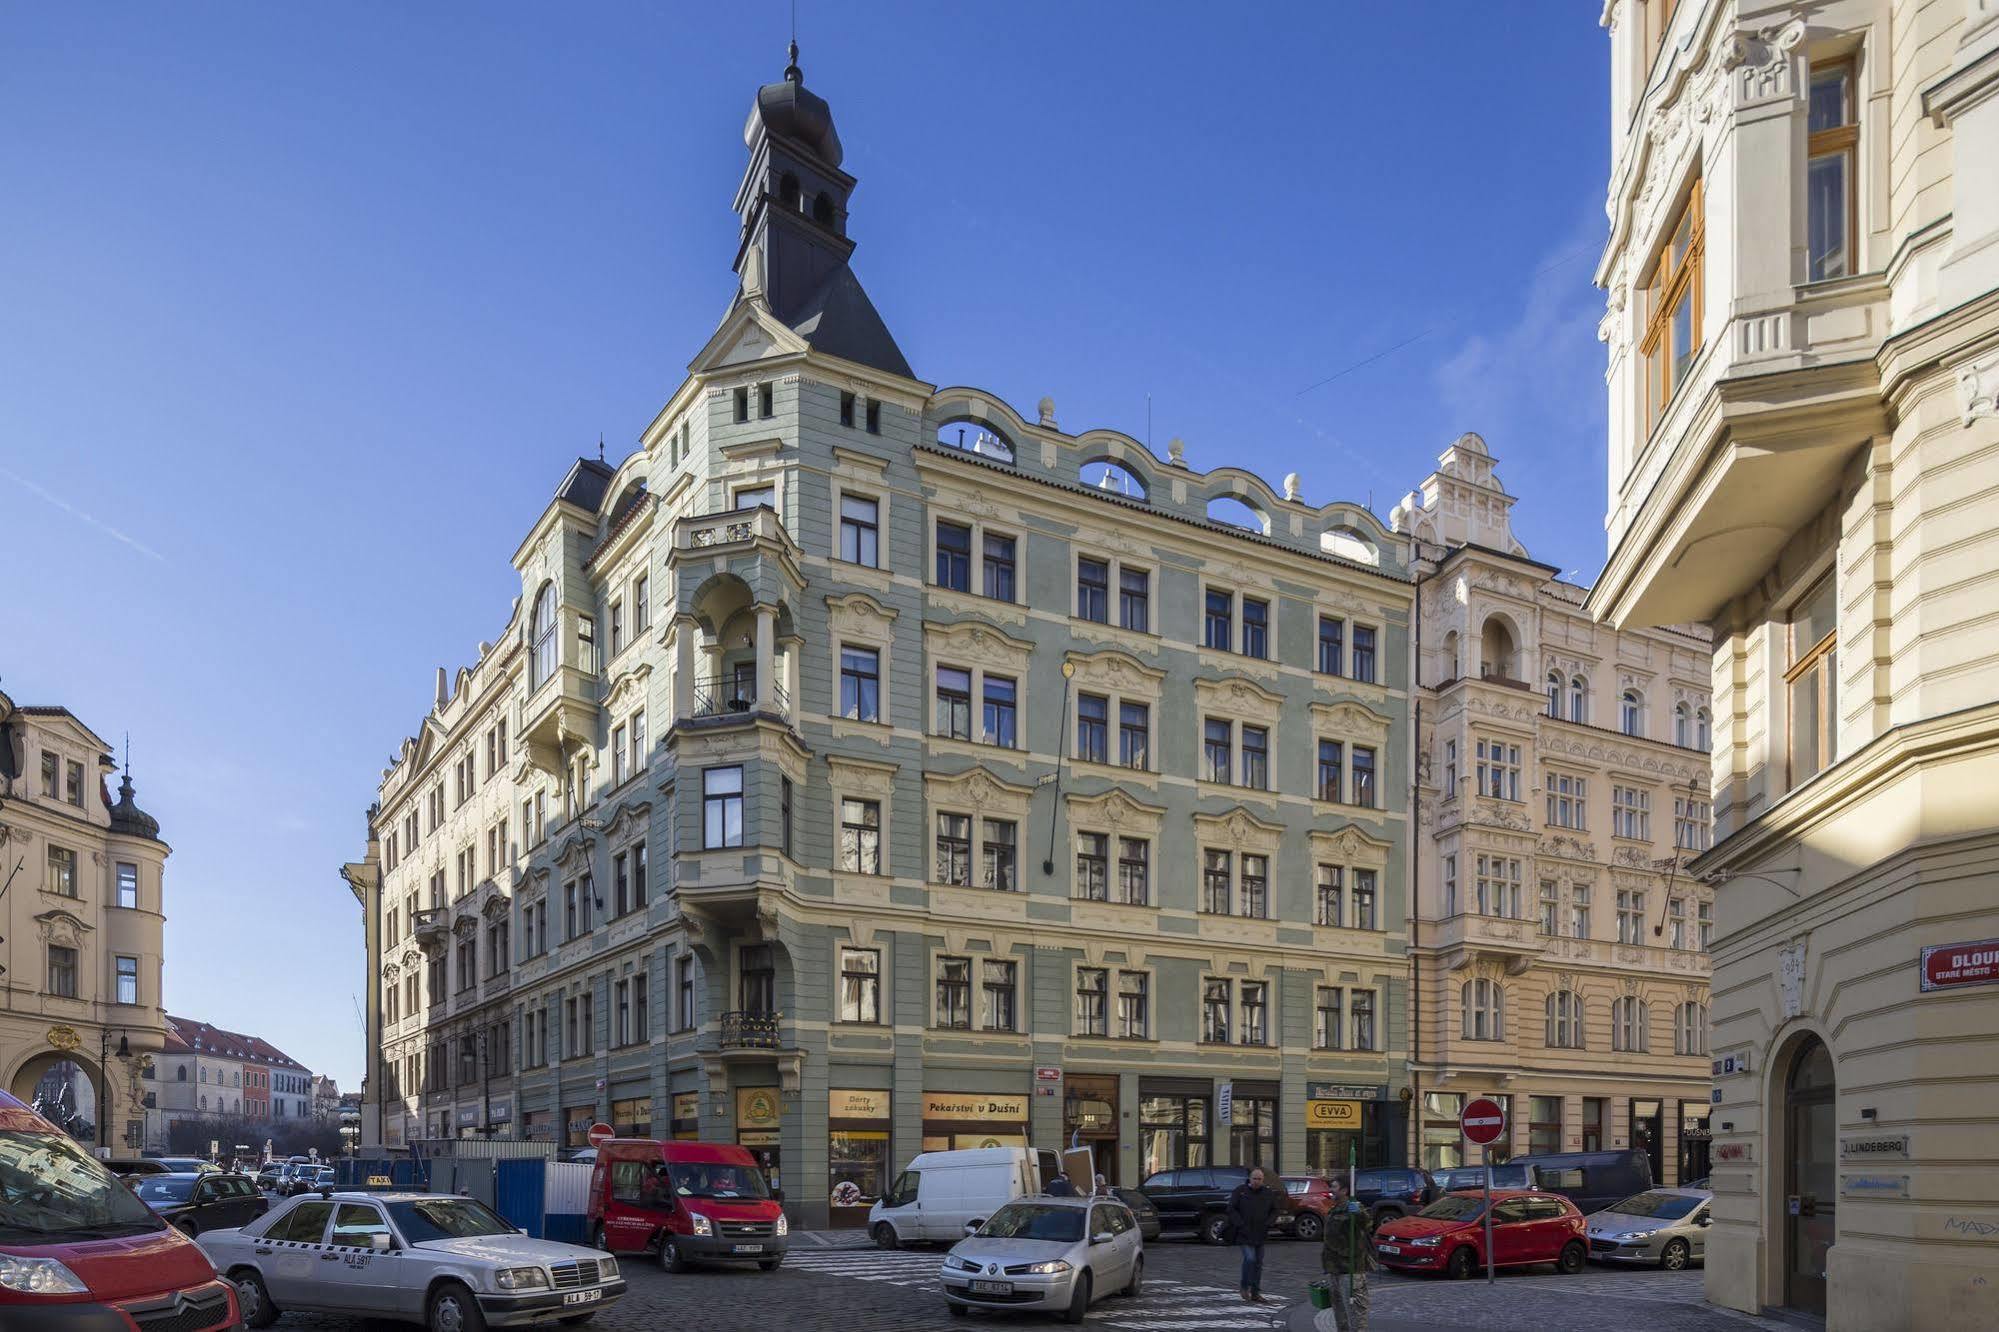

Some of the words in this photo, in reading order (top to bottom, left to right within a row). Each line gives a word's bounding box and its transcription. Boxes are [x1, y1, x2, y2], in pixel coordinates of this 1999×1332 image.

[929, 1102, 973, 1112] Pekařství
[989, 1102, 1020, 1113] Dušní
[1320, 1106, 1346, 1115] EVVA
[370, 1176, 389, 1184] TAXI
[344, 1254, 356, 1264] ALA
